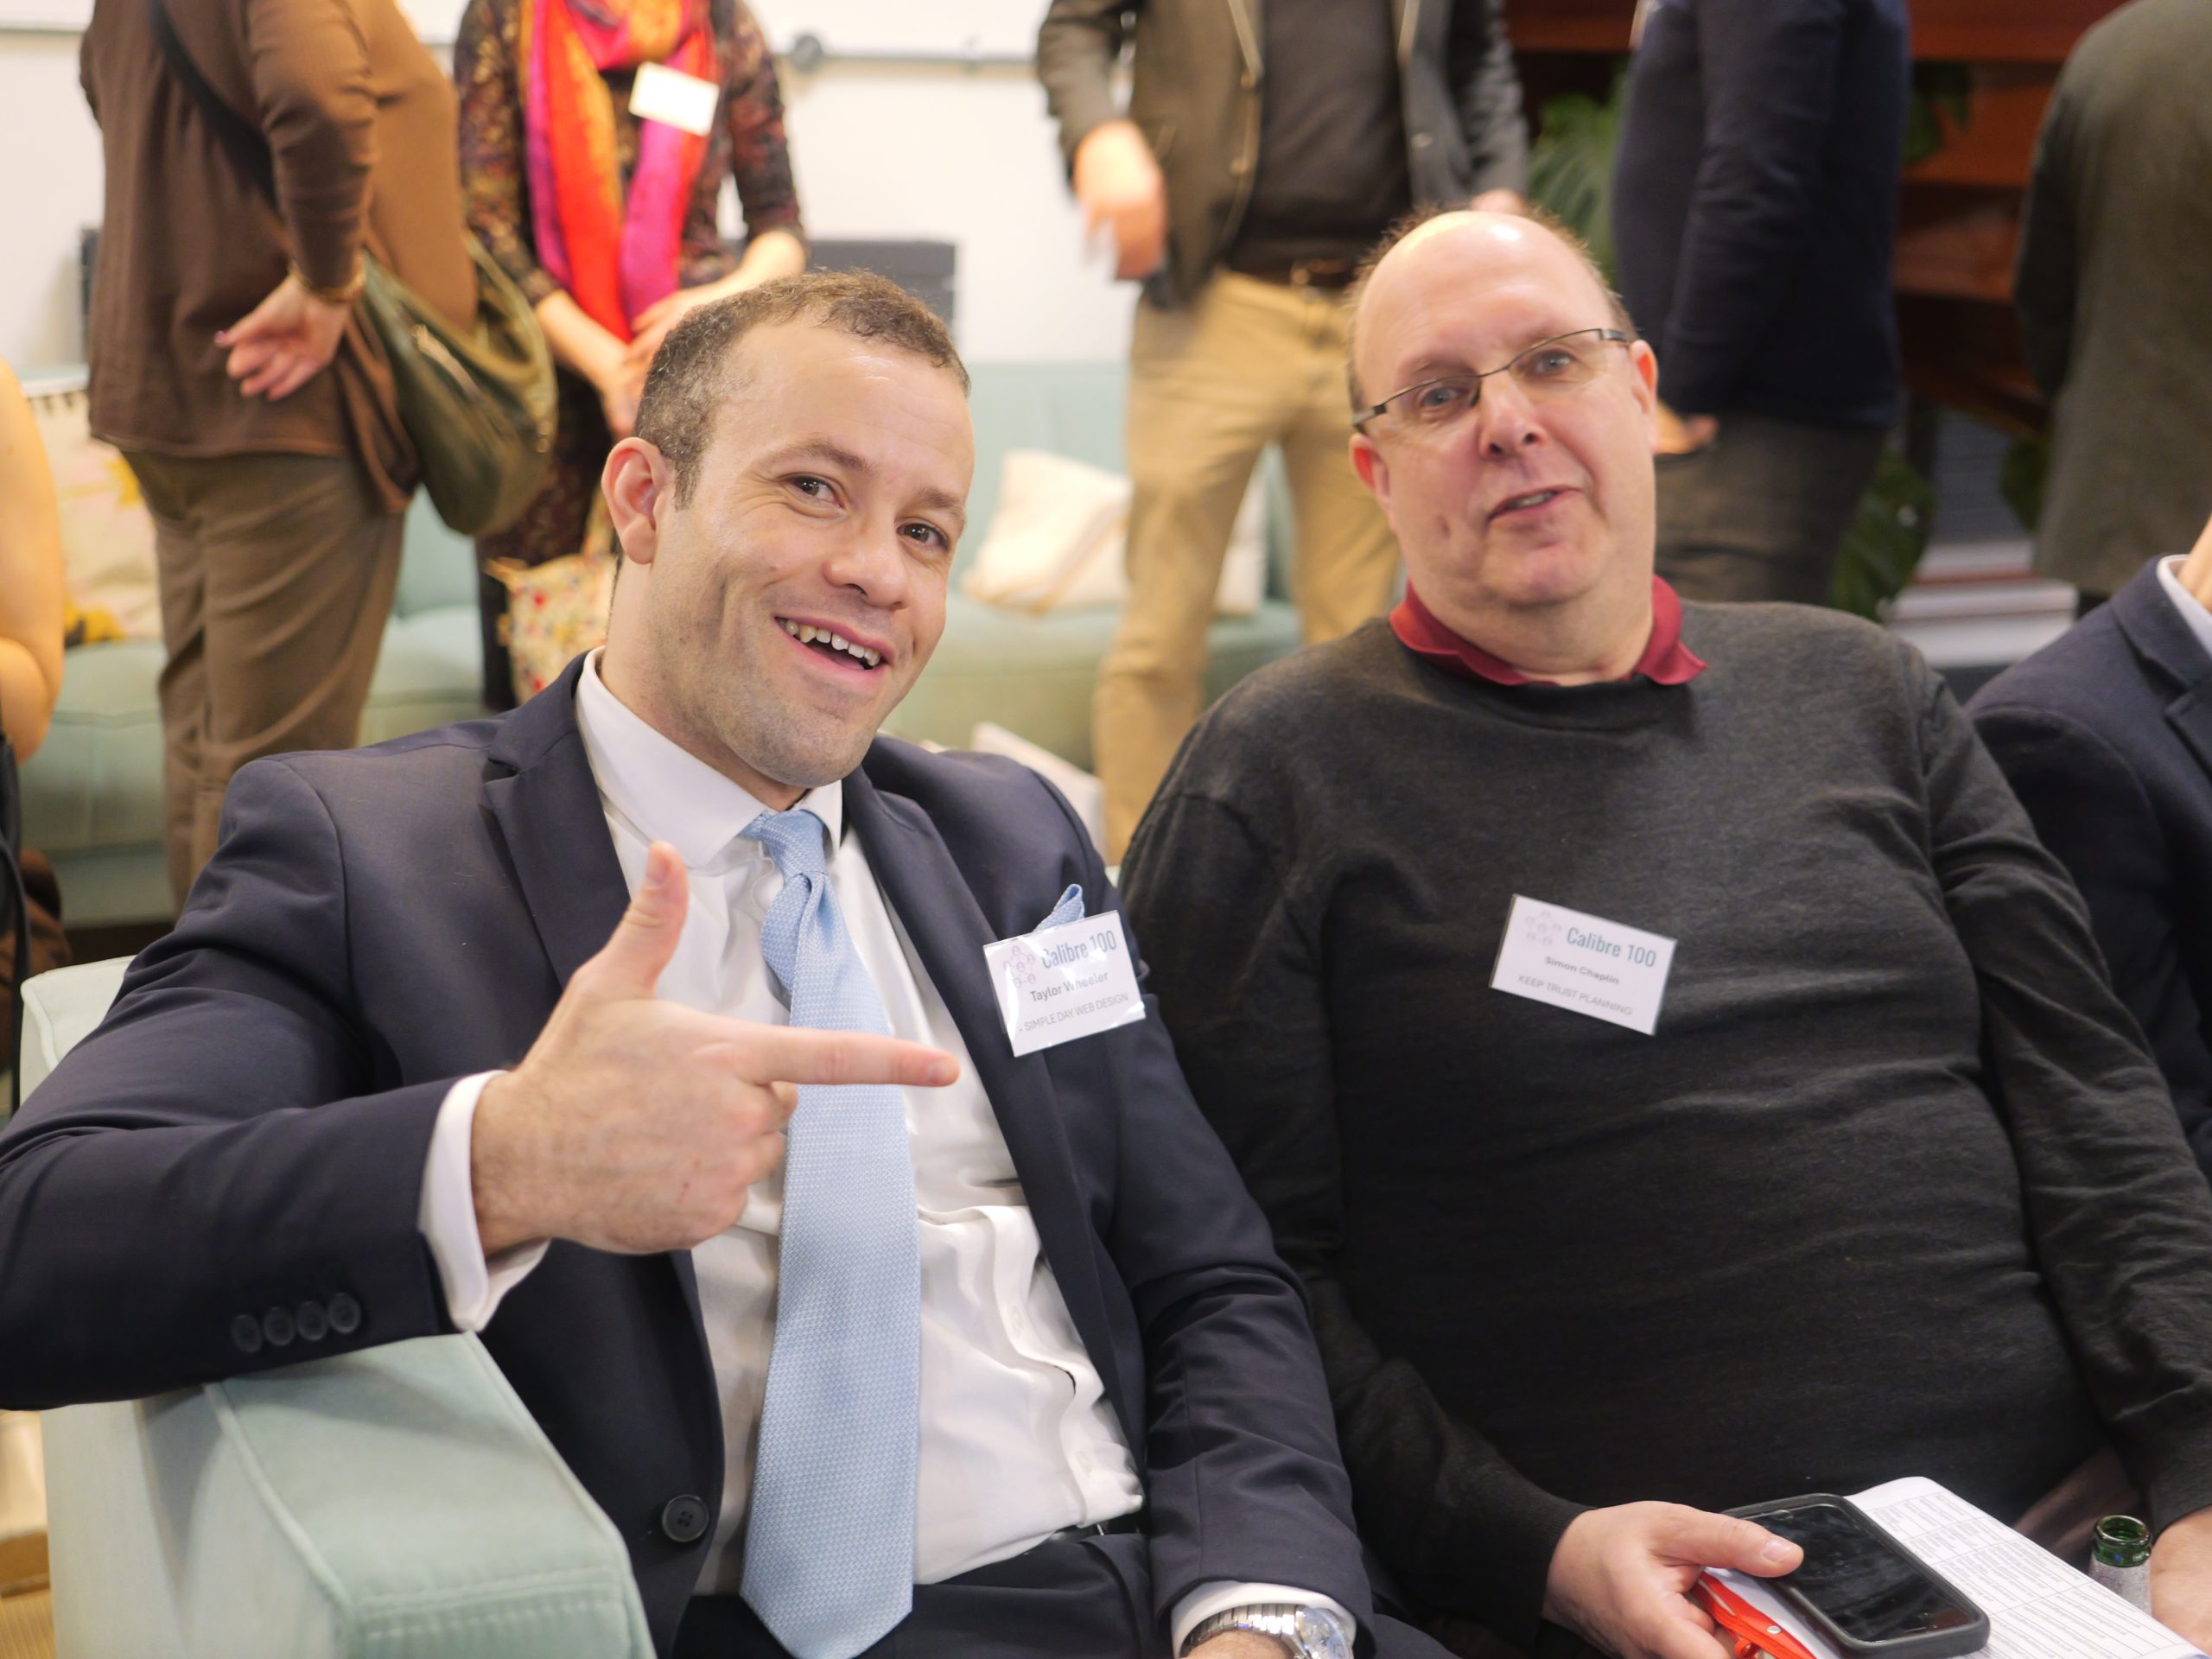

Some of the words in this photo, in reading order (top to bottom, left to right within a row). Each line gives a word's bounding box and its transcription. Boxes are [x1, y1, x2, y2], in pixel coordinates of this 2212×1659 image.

[1040, 942, 1089, 969] Calibre
[1089, 930, 1117, 953] 100
[1566, 926, 1621, 957] Calibre
[1627, 944, 1656, 968] 100
[1030, 985, 1063, 1002] Taylor
[1063, 972, 1109, 993] Wheeler
[1545, 956, 1577, 973] Simon
[1580, 966, 1620, 985] Chaplin
[1024, 1013, 1057, 1032] SIMPLE
[1057, 1007, 1074, 1022] DAY
[1075, 1001, 1096, 1016] WEB
[1096, 992, 1129, 1010] DESIGN
[1518, 974, 1544, 988] KEEP
[1546, 982, 1578, 999] TRUST
[1579, 993, 1633, 1015] PLANNING
